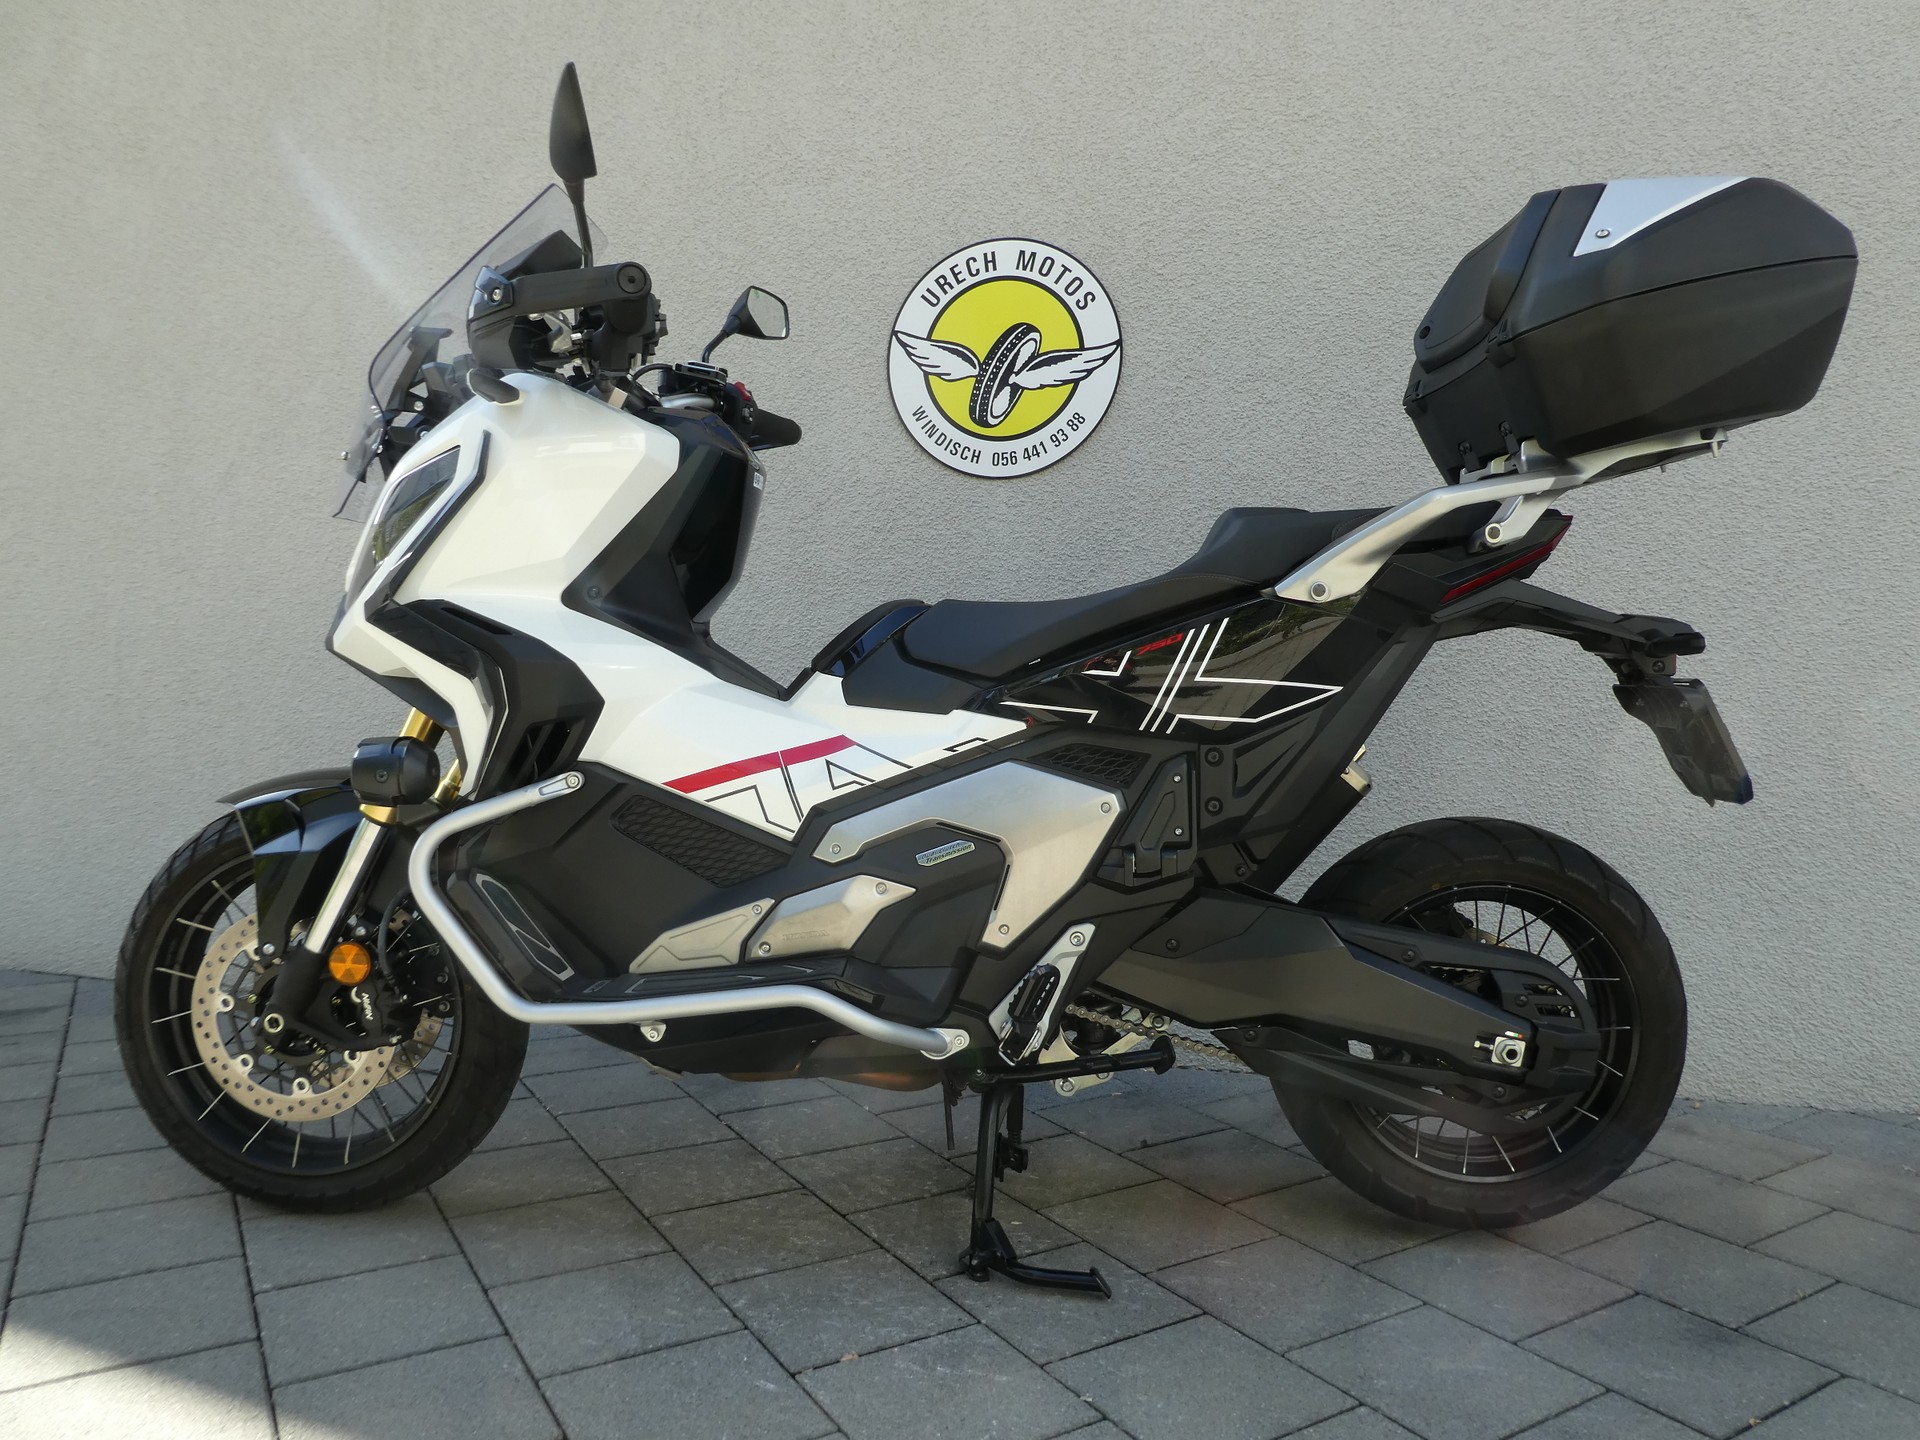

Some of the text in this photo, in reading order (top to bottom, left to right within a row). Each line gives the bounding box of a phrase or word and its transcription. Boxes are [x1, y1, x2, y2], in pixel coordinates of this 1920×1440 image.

[920, 249, 1096, 311] URECH MOTOS
[912, 405, 1086, 467] WINDISCH 056 441 93 88
[1136, 632, 1185, 656] 750
[925, 844, 972, 864] Transmission
